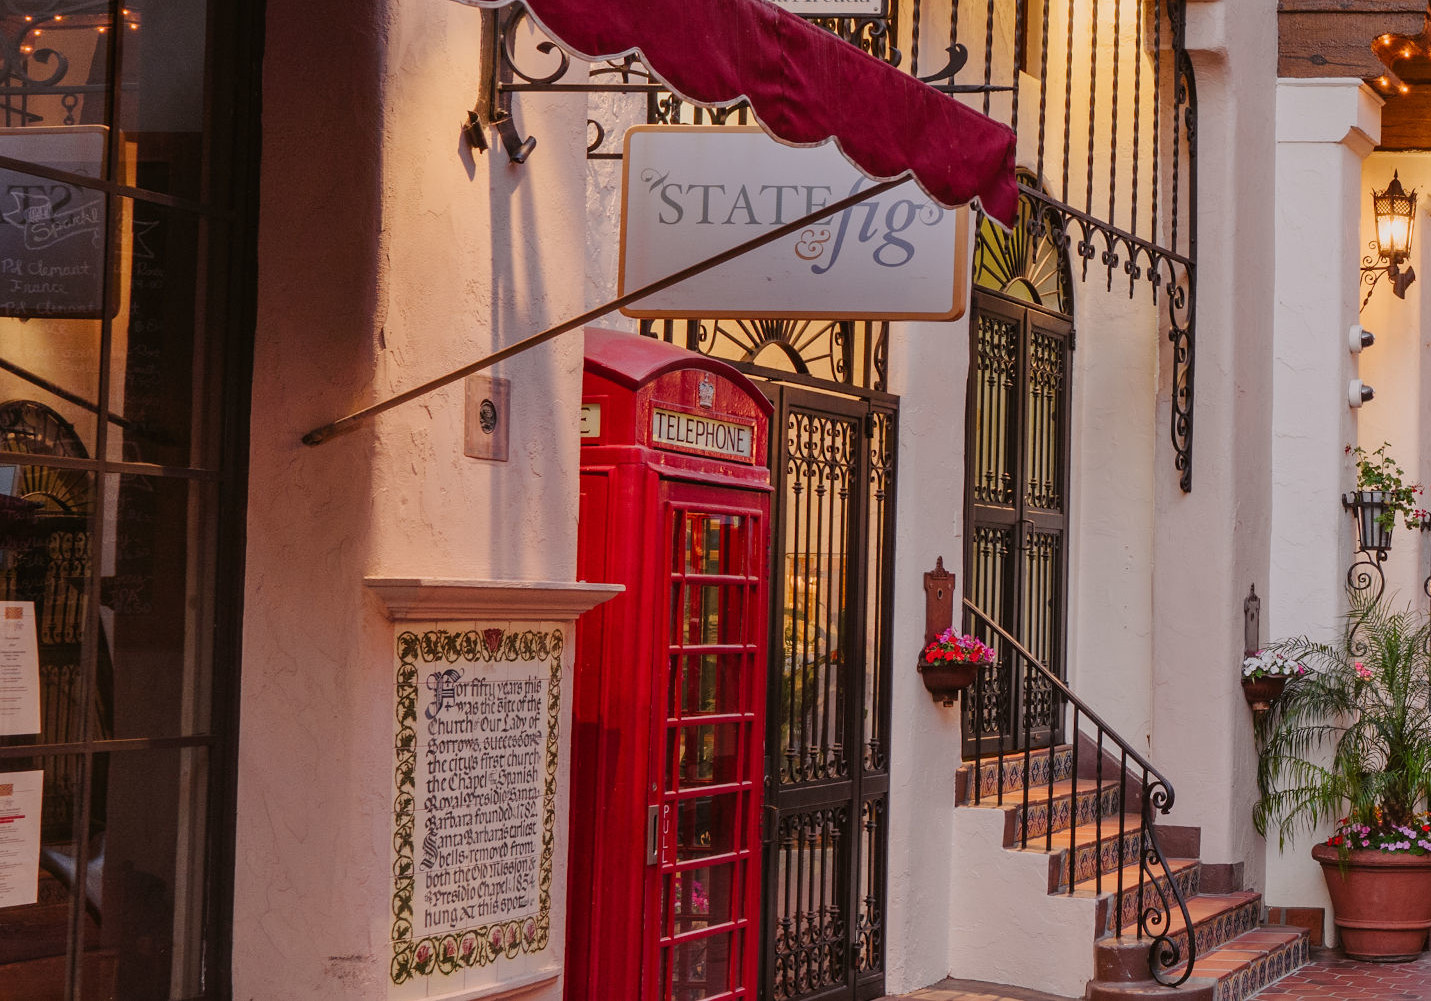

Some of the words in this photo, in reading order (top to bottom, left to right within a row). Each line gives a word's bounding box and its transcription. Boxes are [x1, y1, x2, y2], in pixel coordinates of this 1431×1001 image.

[658, 184, 834, 226] STATE
[811, 177, 943, 274] fig
[794, 229, 831, 260] &
[655, 411, 745, 453] TELEPHONE
[498, 679, 522, 697] years
[524, 676, 541, 695] this
[455, 701, 479, 716] was
[480, 698, 495, 714] the
[497, 697, 515, 713] site
[516, 695, 526, 713] of
[527, 695, 541, 712] the
[427, 716, 473, 736] Church
[480, 716, 502, 733] Our
[502, 714, 527, 733] Lady
[528, 712, 540, 730] of
[427, 754, 447, 775] the
[480, 752, 505, 770] first
[426, 775, 447, 794] the
[448, 771, 488, 794] Chapel
[498, 765, 539, 787] Spanish
[424, 791, 463, 813] Royal
[463, 787, 508, 808] Presidio
[424, 811, 473, 833] Barbara
[475, 803, 512, 825] founded
[420, 829, 463, 870] Santa
[509, 820, 537, 840] earliest
[661, 804, 670, 864] PULL
[469, 842, 508, 863] removed
[426, 869, 451, 889] both
[453, 866, 470, 883] the
[471, 863, 488, 880] Old
[489, 858, 528, 879] Mission
[432, 884, 476, 907] Presidio
[477, 878, 508, 901] Chapel
[424, 907, 458, 928] hung
[478, 899, 499, 917] this
